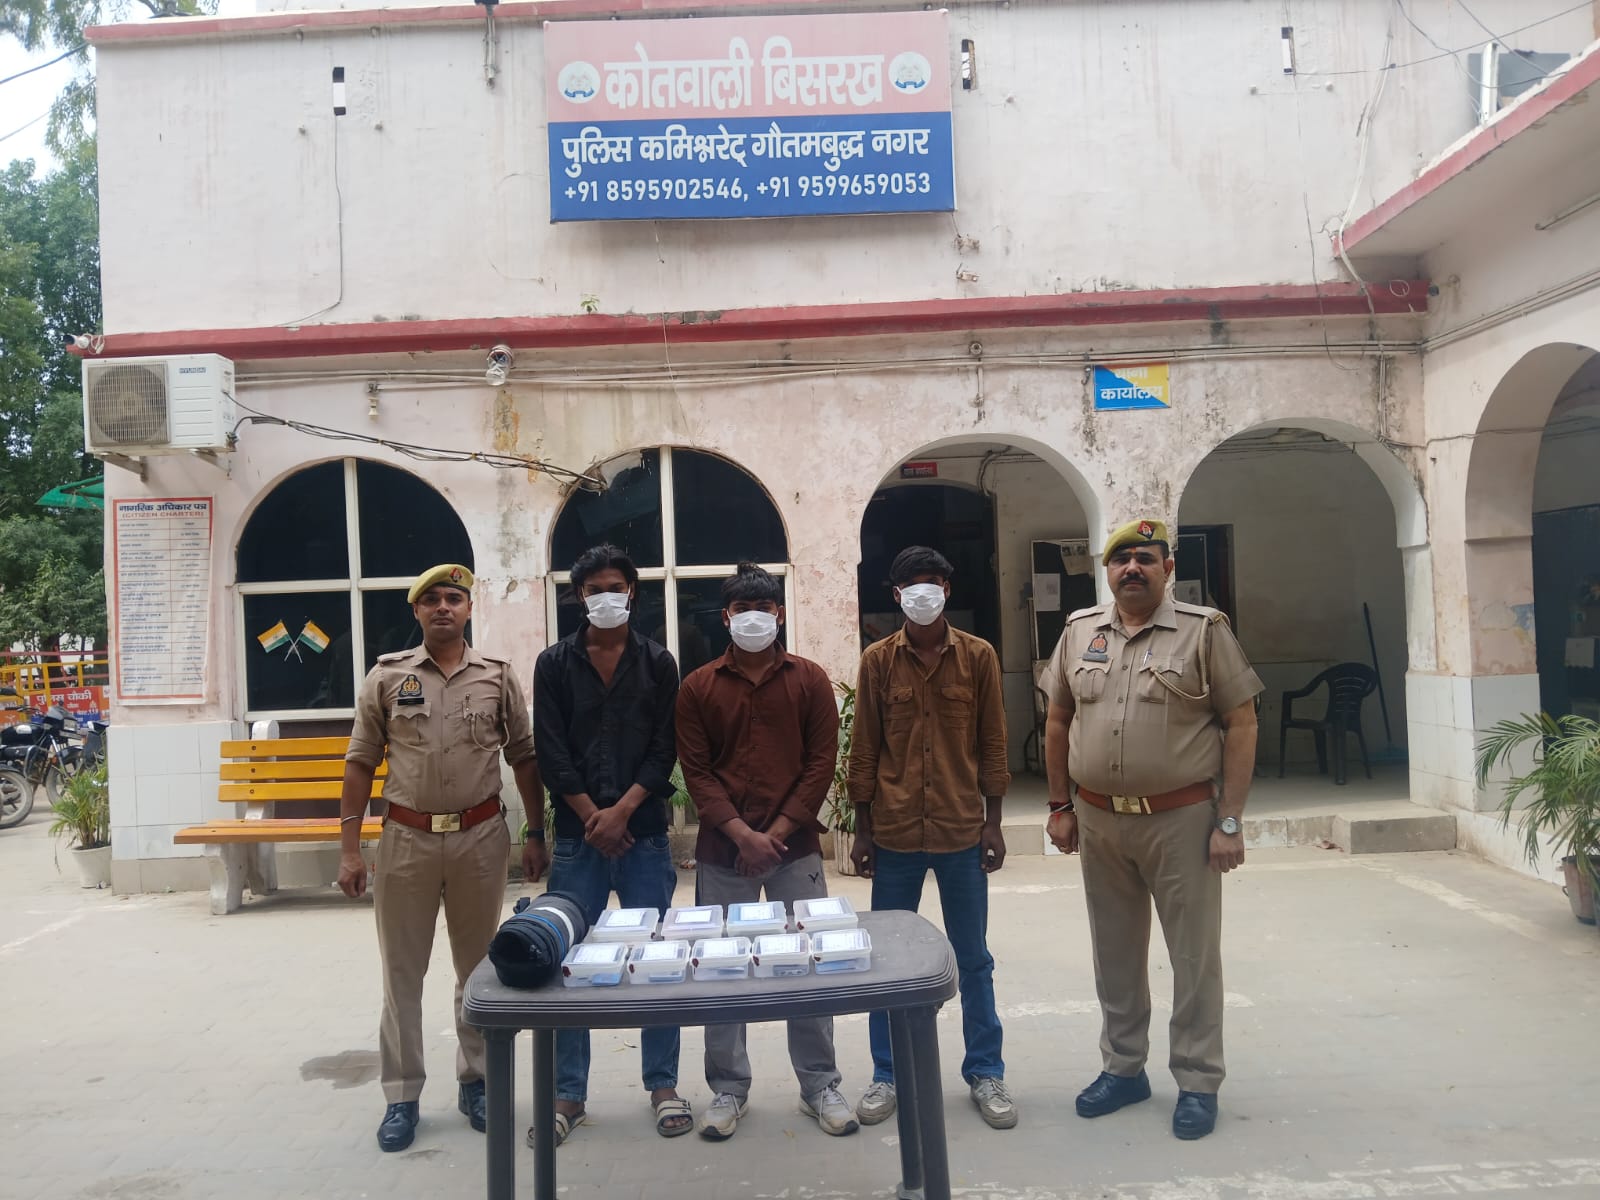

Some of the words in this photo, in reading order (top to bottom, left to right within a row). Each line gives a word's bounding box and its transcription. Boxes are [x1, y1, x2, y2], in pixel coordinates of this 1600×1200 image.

[604, 36, 753, 111] कोतवाली
[761, 35, 885, 107] बिसरख
[562, 126, 633, 178] पुलिस
[751, 121, 865, 172] गौतमबुद्ध
[871, 128, 930, 156] नगर
[565, 181, 598, 203] +91
[607, 176, 749, 202] 8595902546,
[756, 176, 790, 198] +91
[799, 172, 931, 198] 9599659053
[119, 503, 154, 511] नागरिक
[156, 502, 192, 511] अधिकार
[36, 693, 64, 705] पुस
